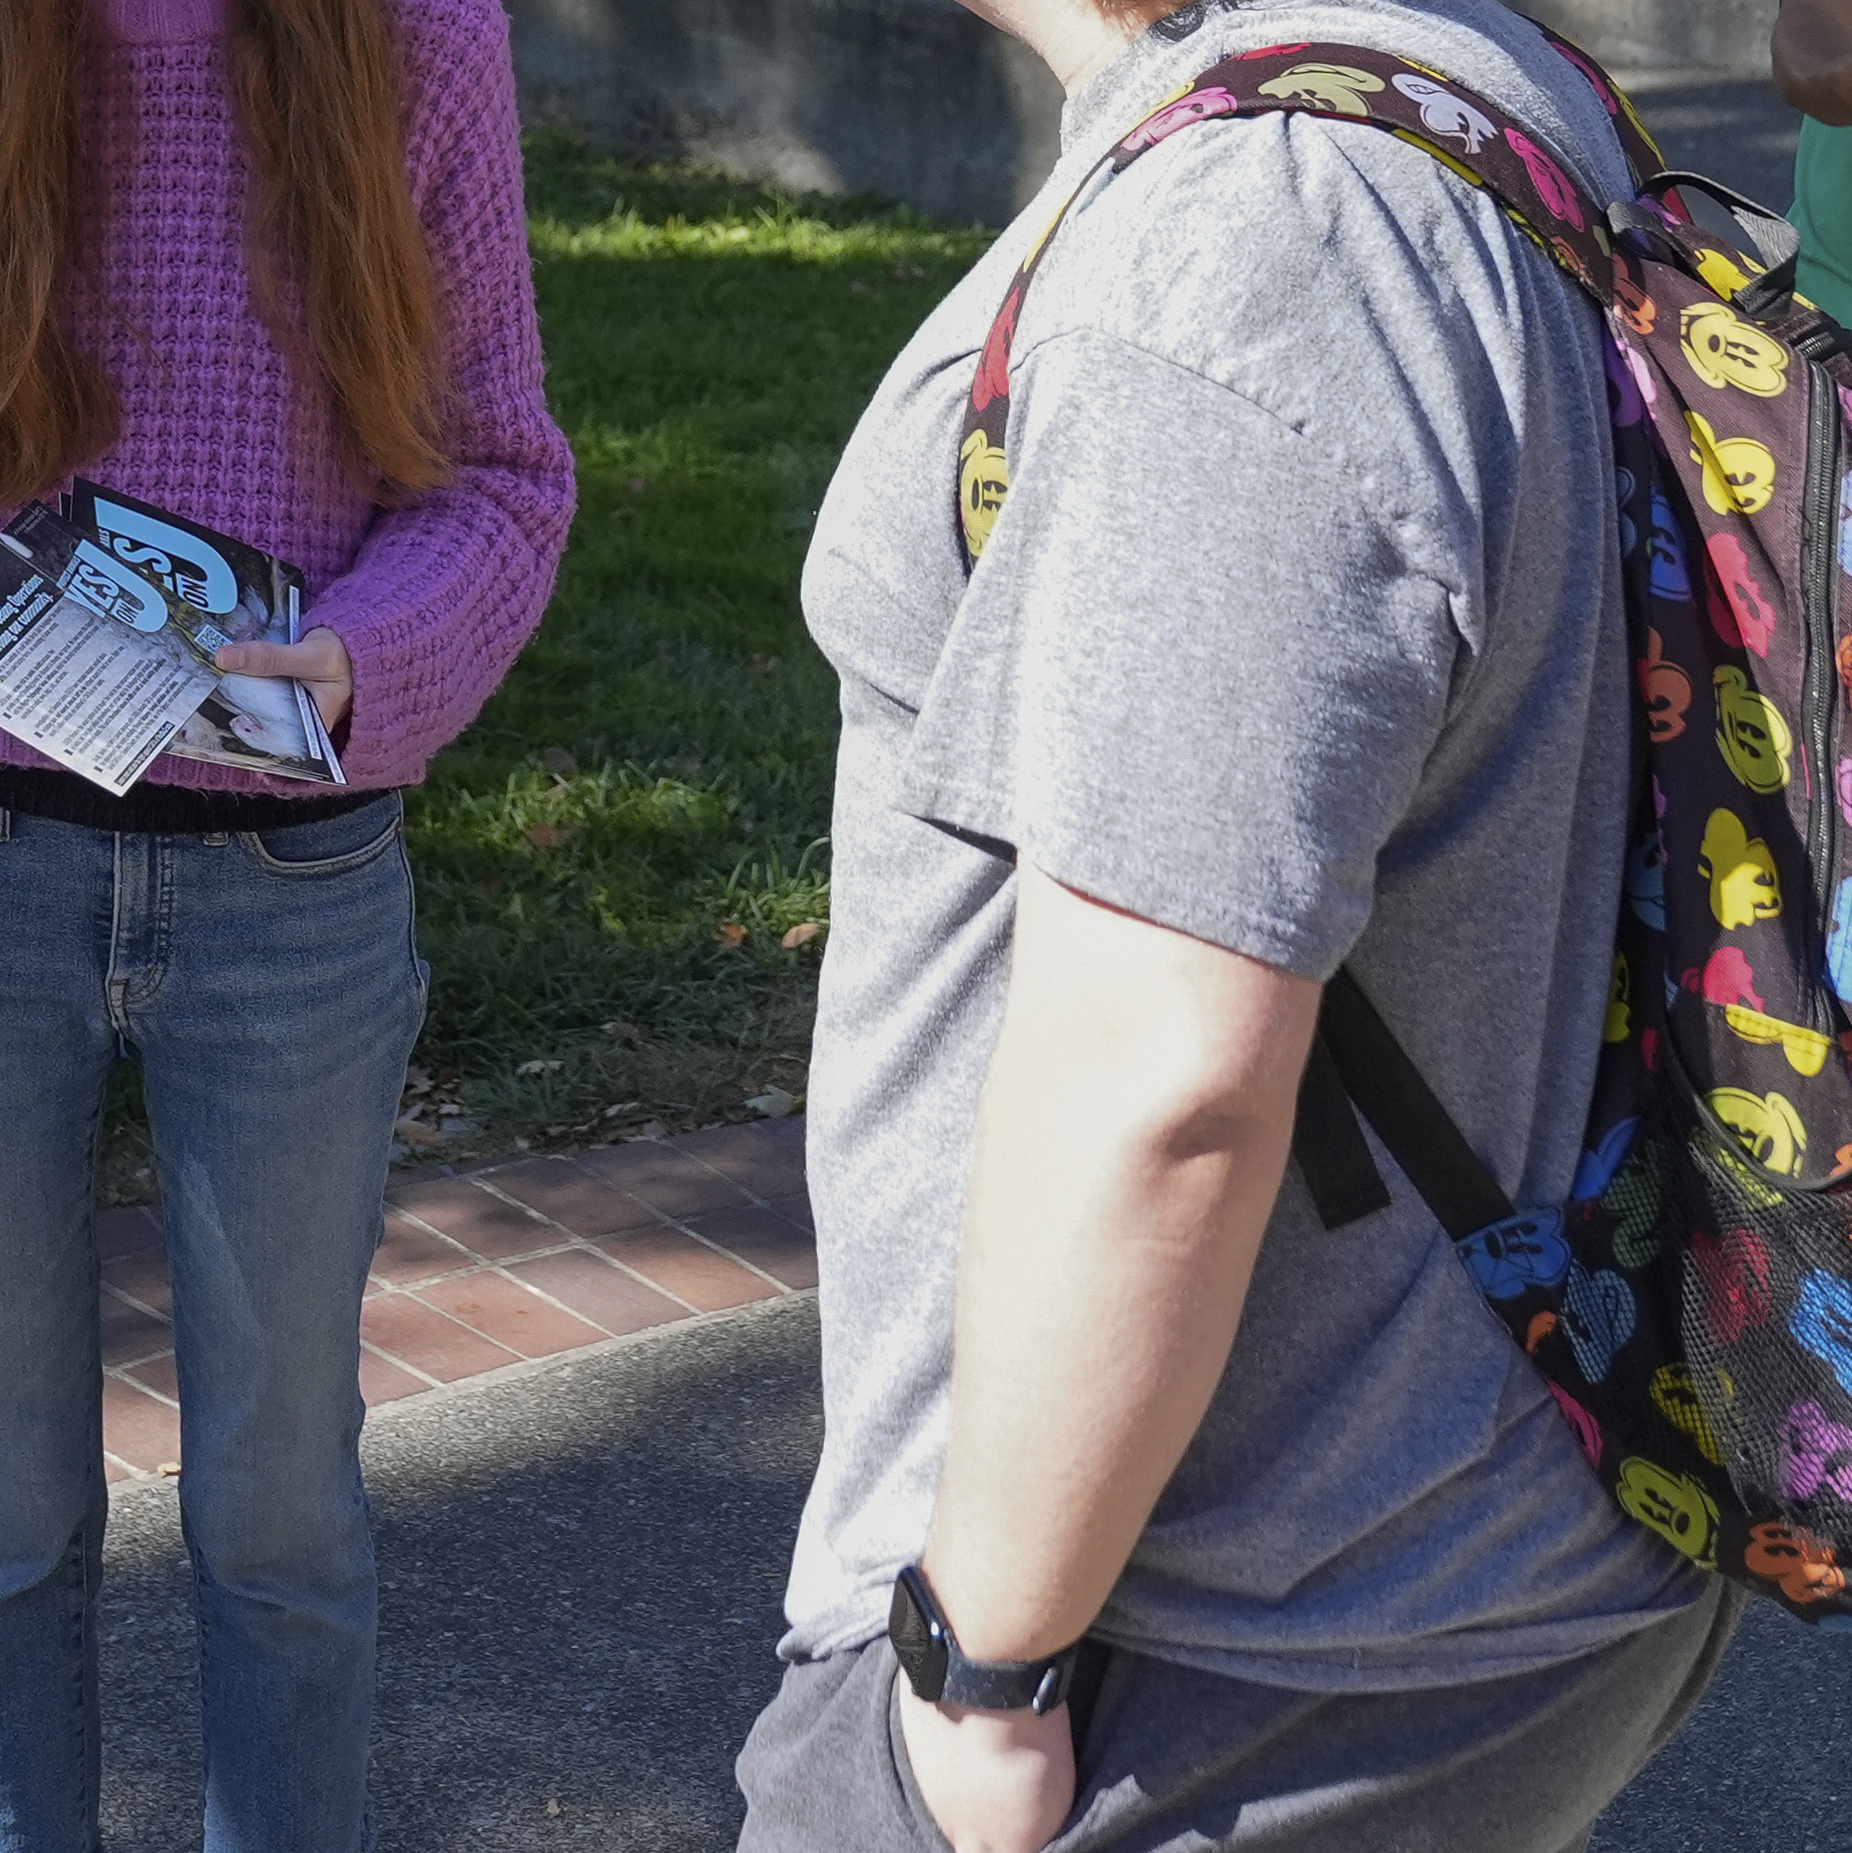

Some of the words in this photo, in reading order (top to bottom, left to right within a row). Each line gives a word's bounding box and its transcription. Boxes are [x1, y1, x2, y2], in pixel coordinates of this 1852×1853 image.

[63, 563, 120, 619] YES
[181, 575, 210, 610] ON
[115, 599, 140, 626] ON
